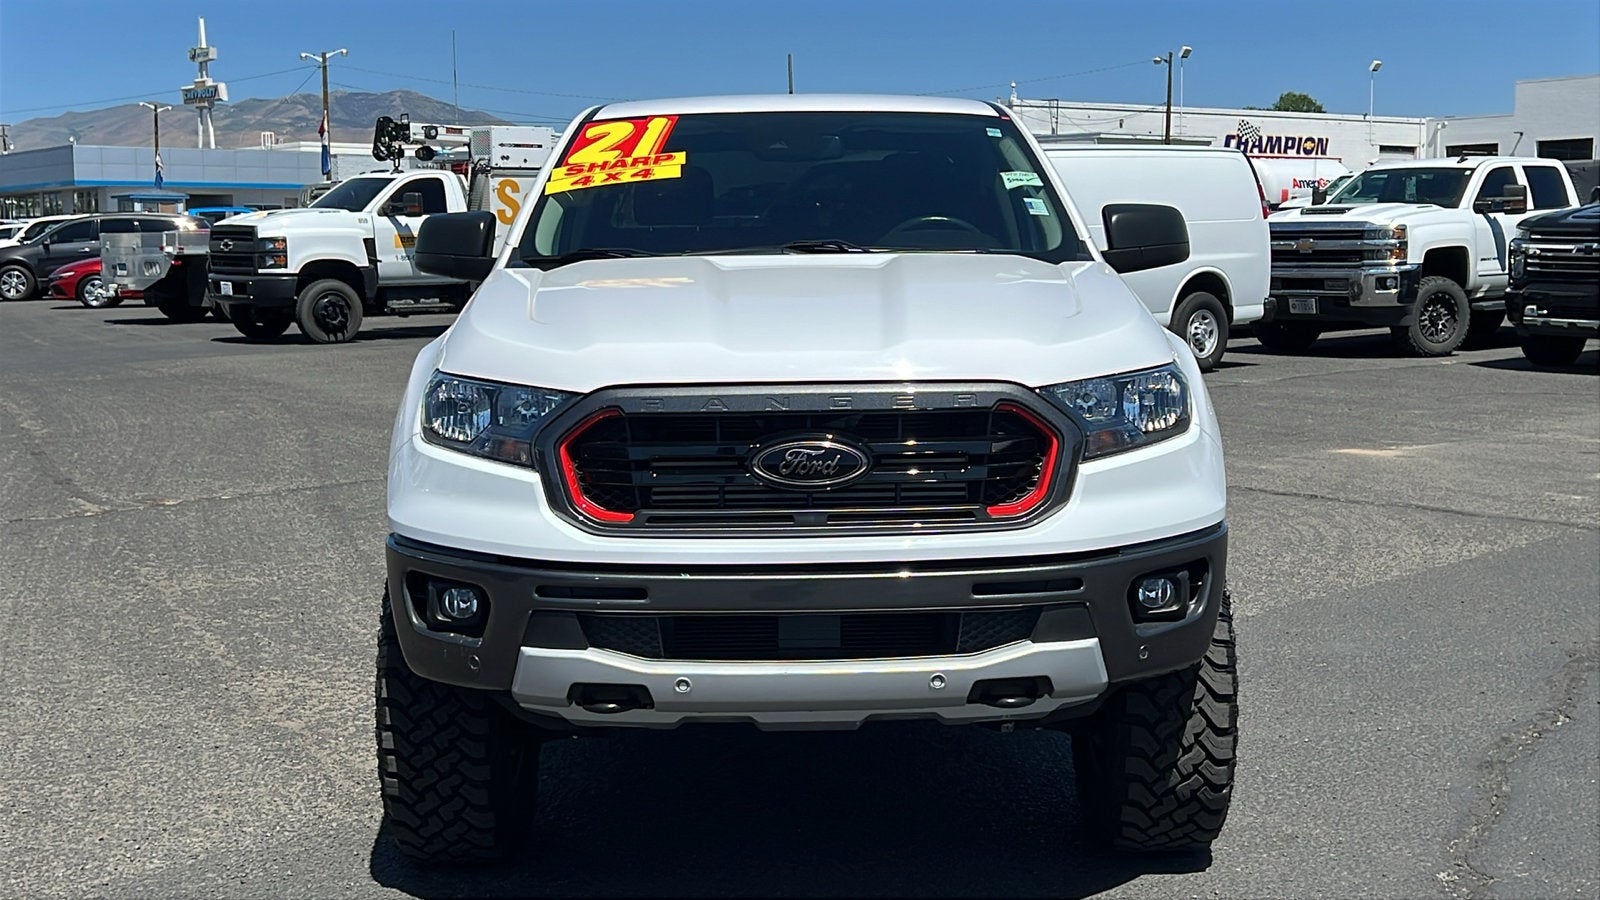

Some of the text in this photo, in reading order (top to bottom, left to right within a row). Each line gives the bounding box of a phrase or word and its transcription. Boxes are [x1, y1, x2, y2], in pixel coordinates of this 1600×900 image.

[567, 116, 672, 165] 21
[1224, 134, 1329, 156] CHAMPION
[564, 153, 676, 177] SHARP
[640, 393, 978, 412] RANGER
[778, 447, 841, 477] Ford
